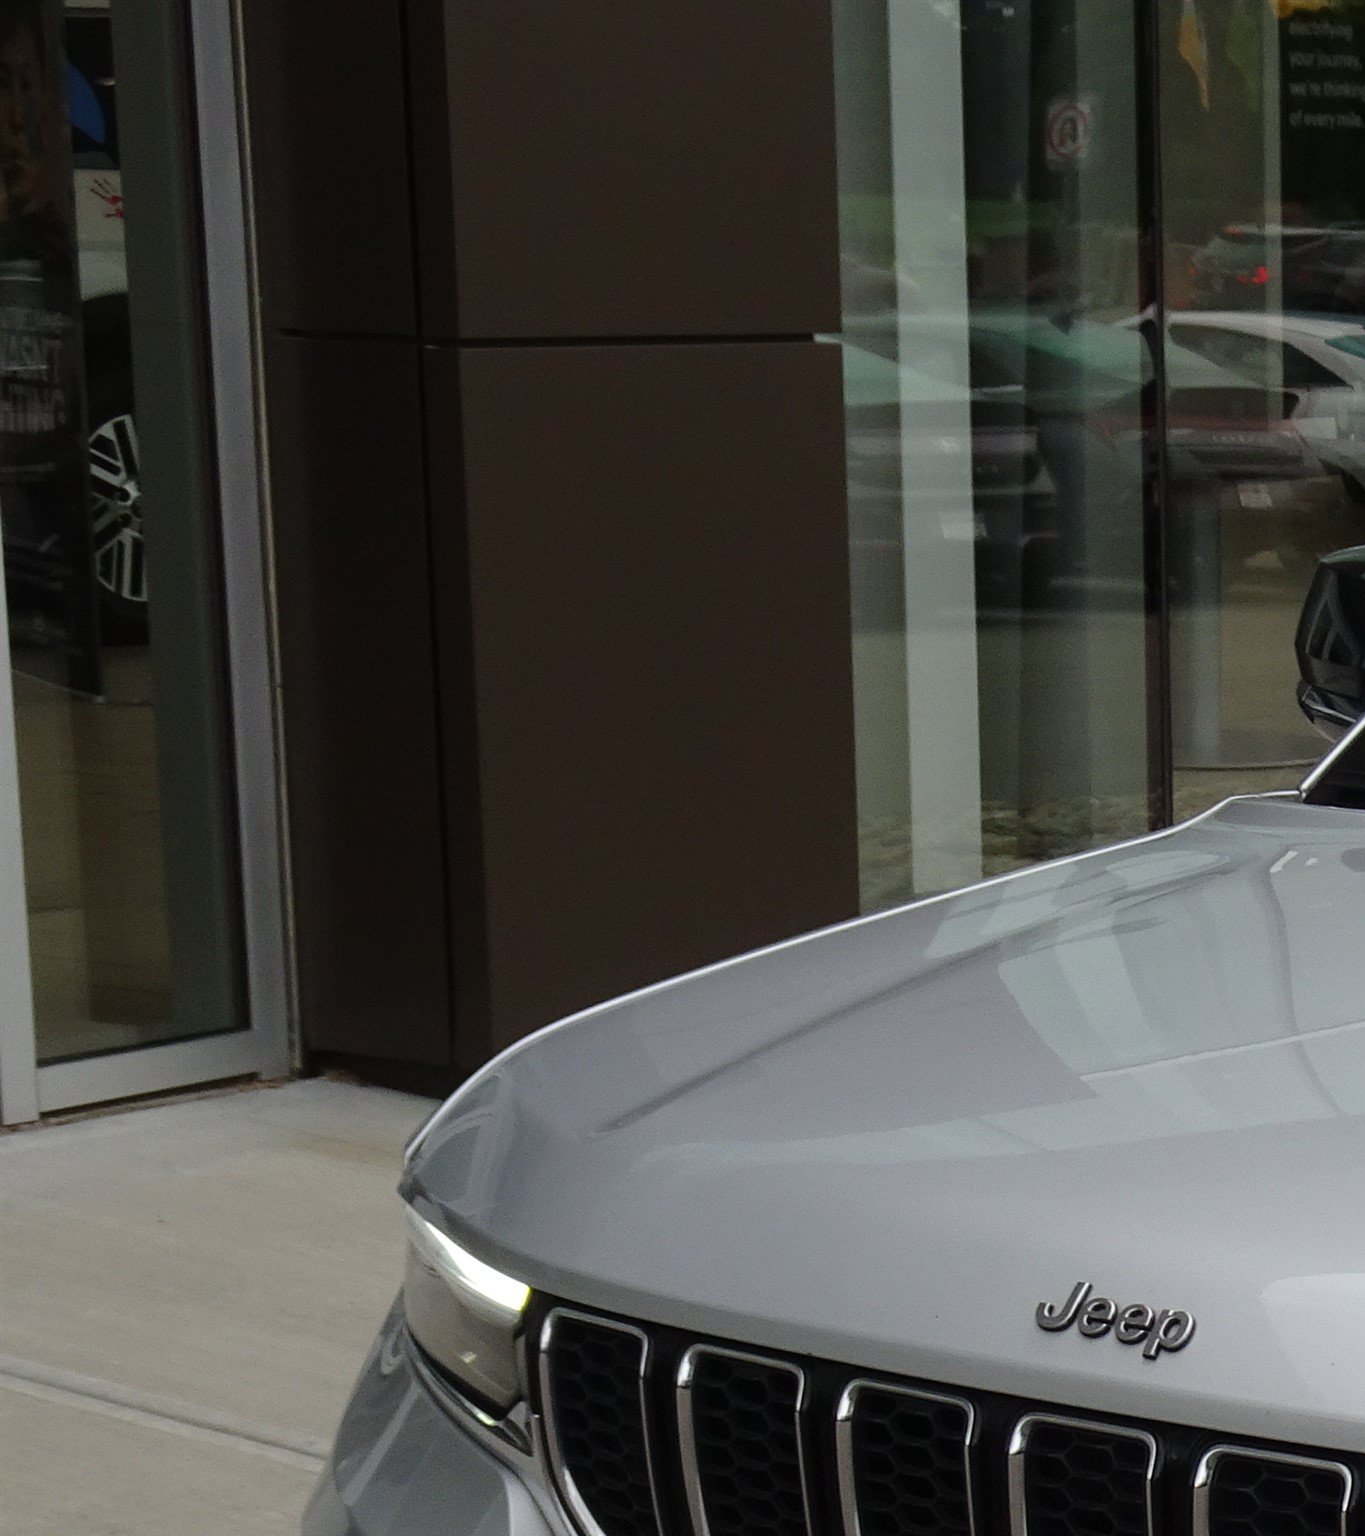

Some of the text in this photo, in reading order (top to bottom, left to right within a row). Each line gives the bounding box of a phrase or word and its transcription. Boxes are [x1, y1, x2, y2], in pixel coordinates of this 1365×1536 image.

[1288, 109, 1302, 127] of
[1303, 112, 1335, 129] every
[1035, 1281, 1197, 1361] Jeep
